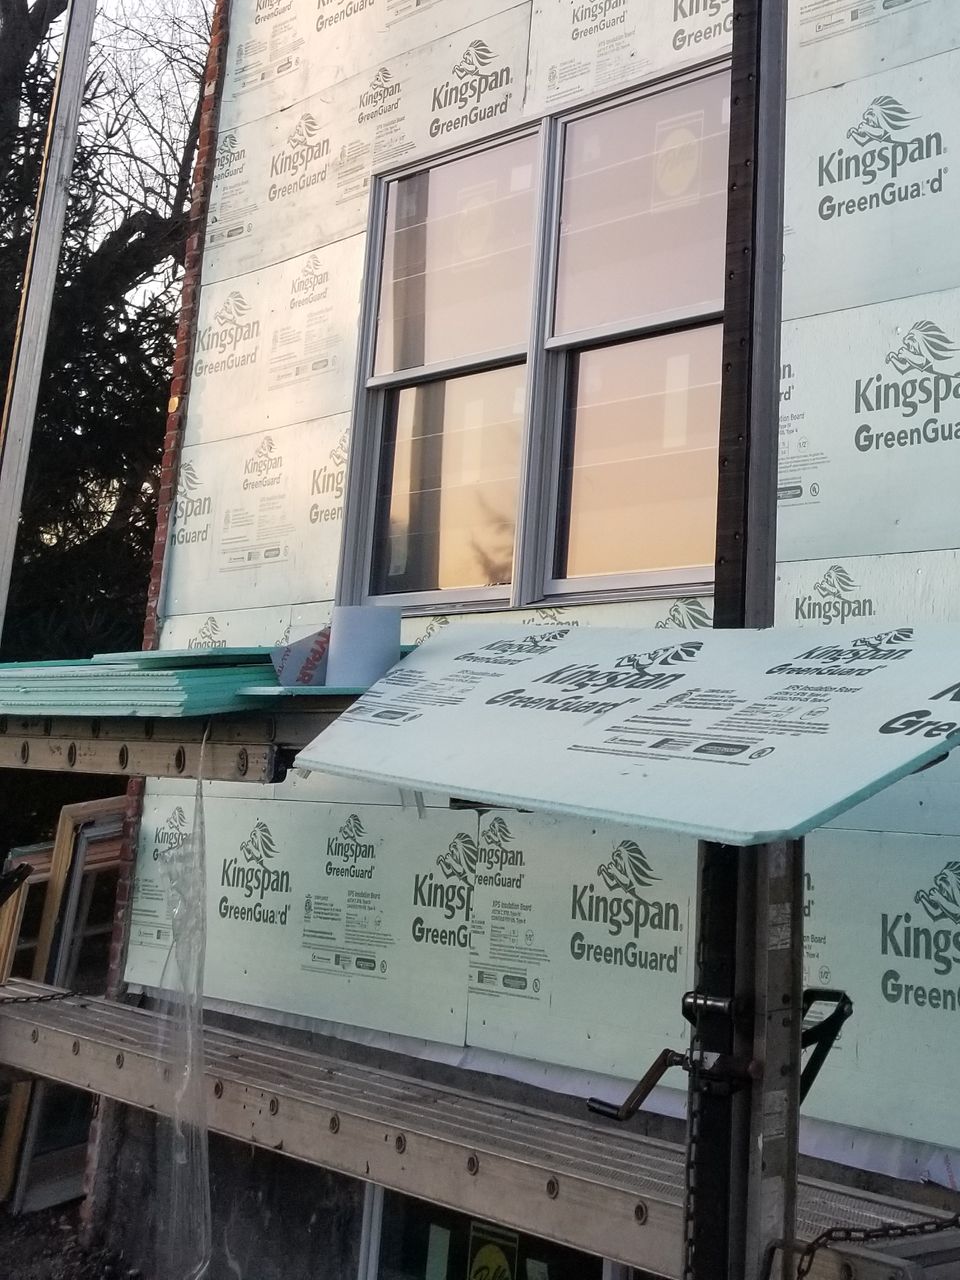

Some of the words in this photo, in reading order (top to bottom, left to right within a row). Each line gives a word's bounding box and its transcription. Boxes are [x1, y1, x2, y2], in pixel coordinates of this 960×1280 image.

[673, 12, 733, 51] GreenG
[431, 65, 510, 113] Kingspan
[429, 94, 509, 138] GreenGuard
[270, 138, 329, 178] Kingspan
[818, 131, 943, 188] Kingspan
[795, 596, 873, 625] Kingspan
[532, 663, 686, 694] Kingspan
[485, 688, 632, 715] GreenGuard
[325, 861, 374, 879] GreenGuard
[326, 837, 375, 864] Kingspan
[221, 858, 290, 900] Kingspan
[572, 885, 679, 938] Kingspan
[570, 931, 678, 973] GreenGuard
